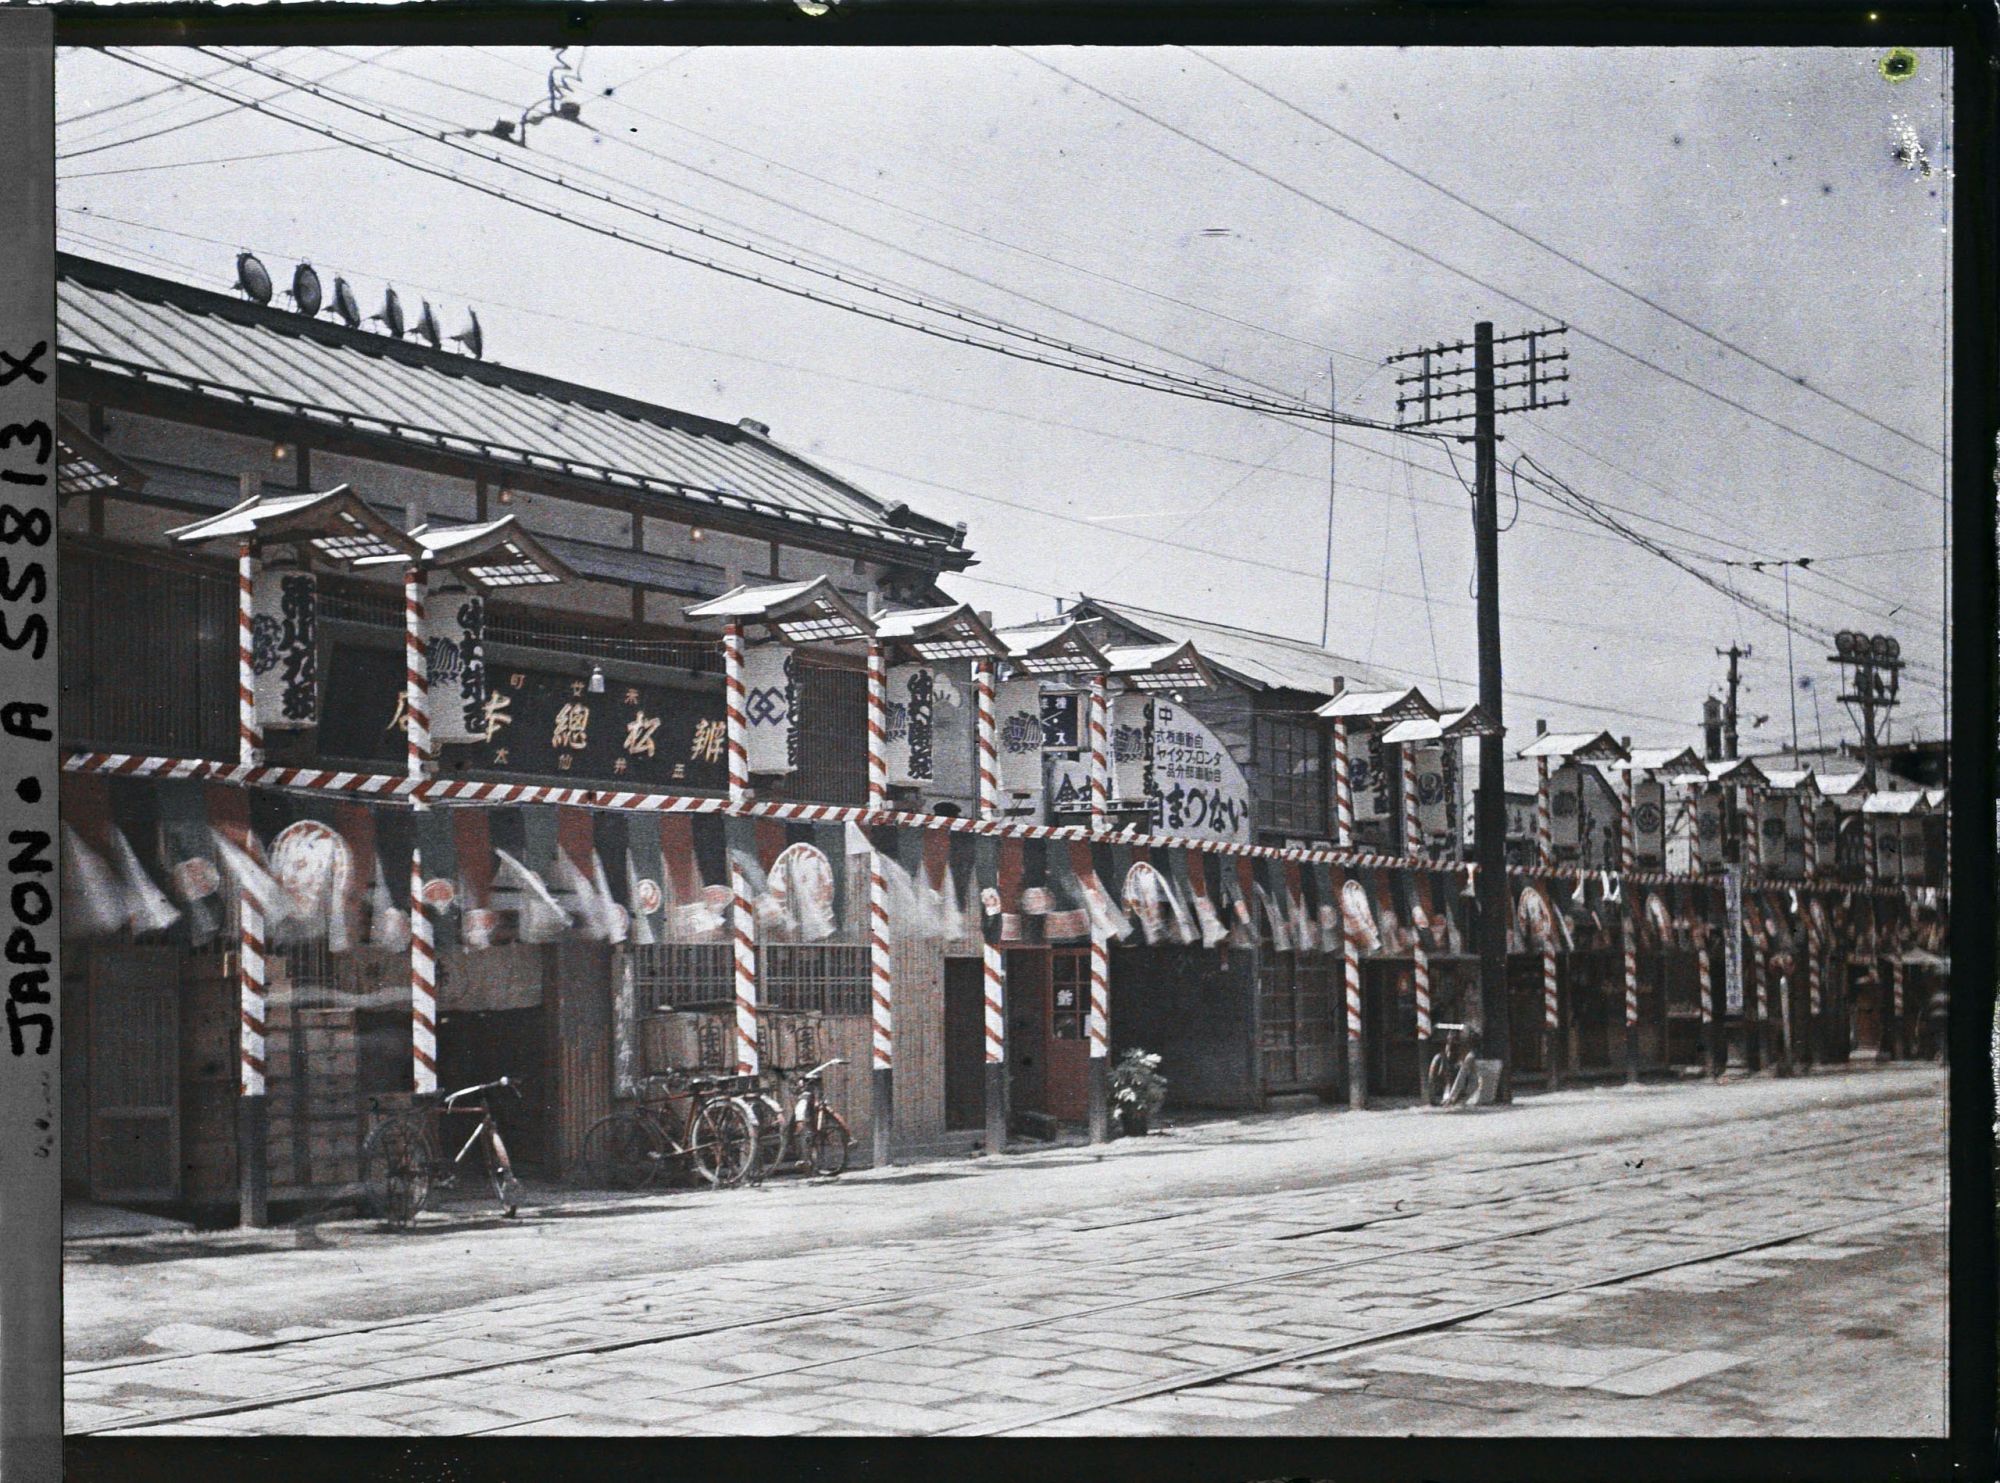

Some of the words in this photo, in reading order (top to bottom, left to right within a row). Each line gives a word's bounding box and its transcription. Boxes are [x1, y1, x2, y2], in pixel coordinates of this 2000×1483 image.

[0, 340, 48, 387] X
[0, 700, 53, 742] A
[5, 829, 54, 1057] JAPON
